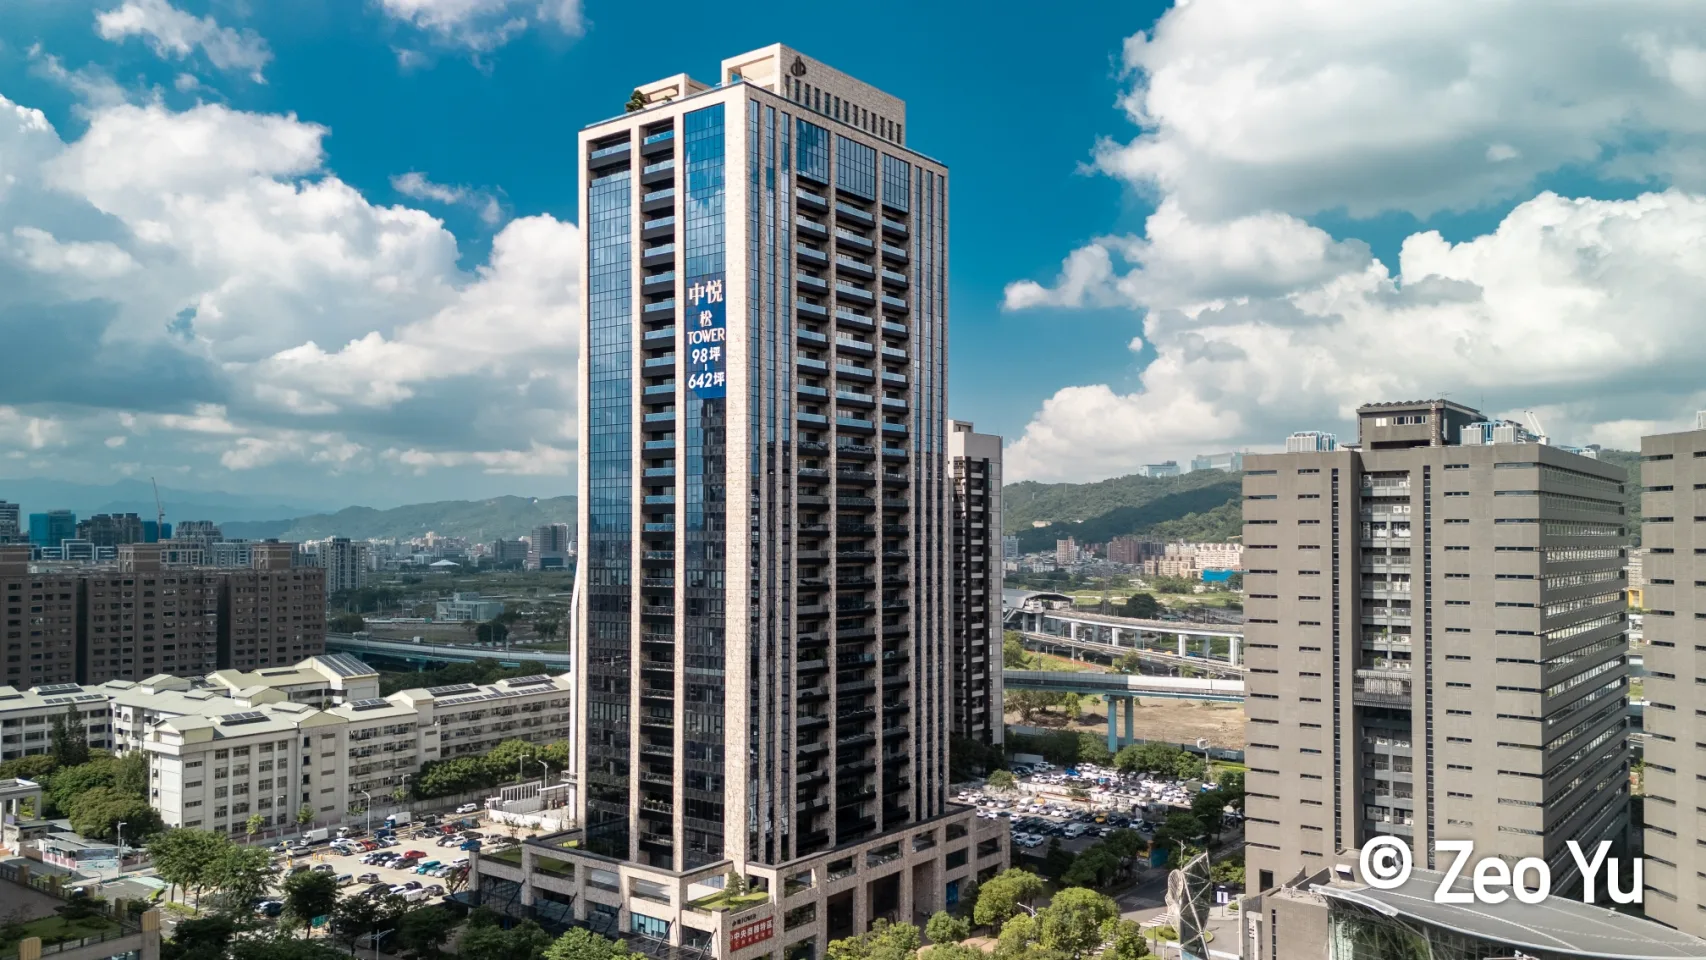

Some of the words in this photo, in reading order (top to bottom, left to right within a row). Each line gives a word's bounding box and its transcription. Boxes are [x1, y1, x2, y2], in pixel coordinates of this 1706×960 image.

[700, 310, 712, 327] 松
[687, 328, 725, 345] TOWER
[692, 346, 721, 364] 98坪
[688, 372, 725, 389] 642坪
